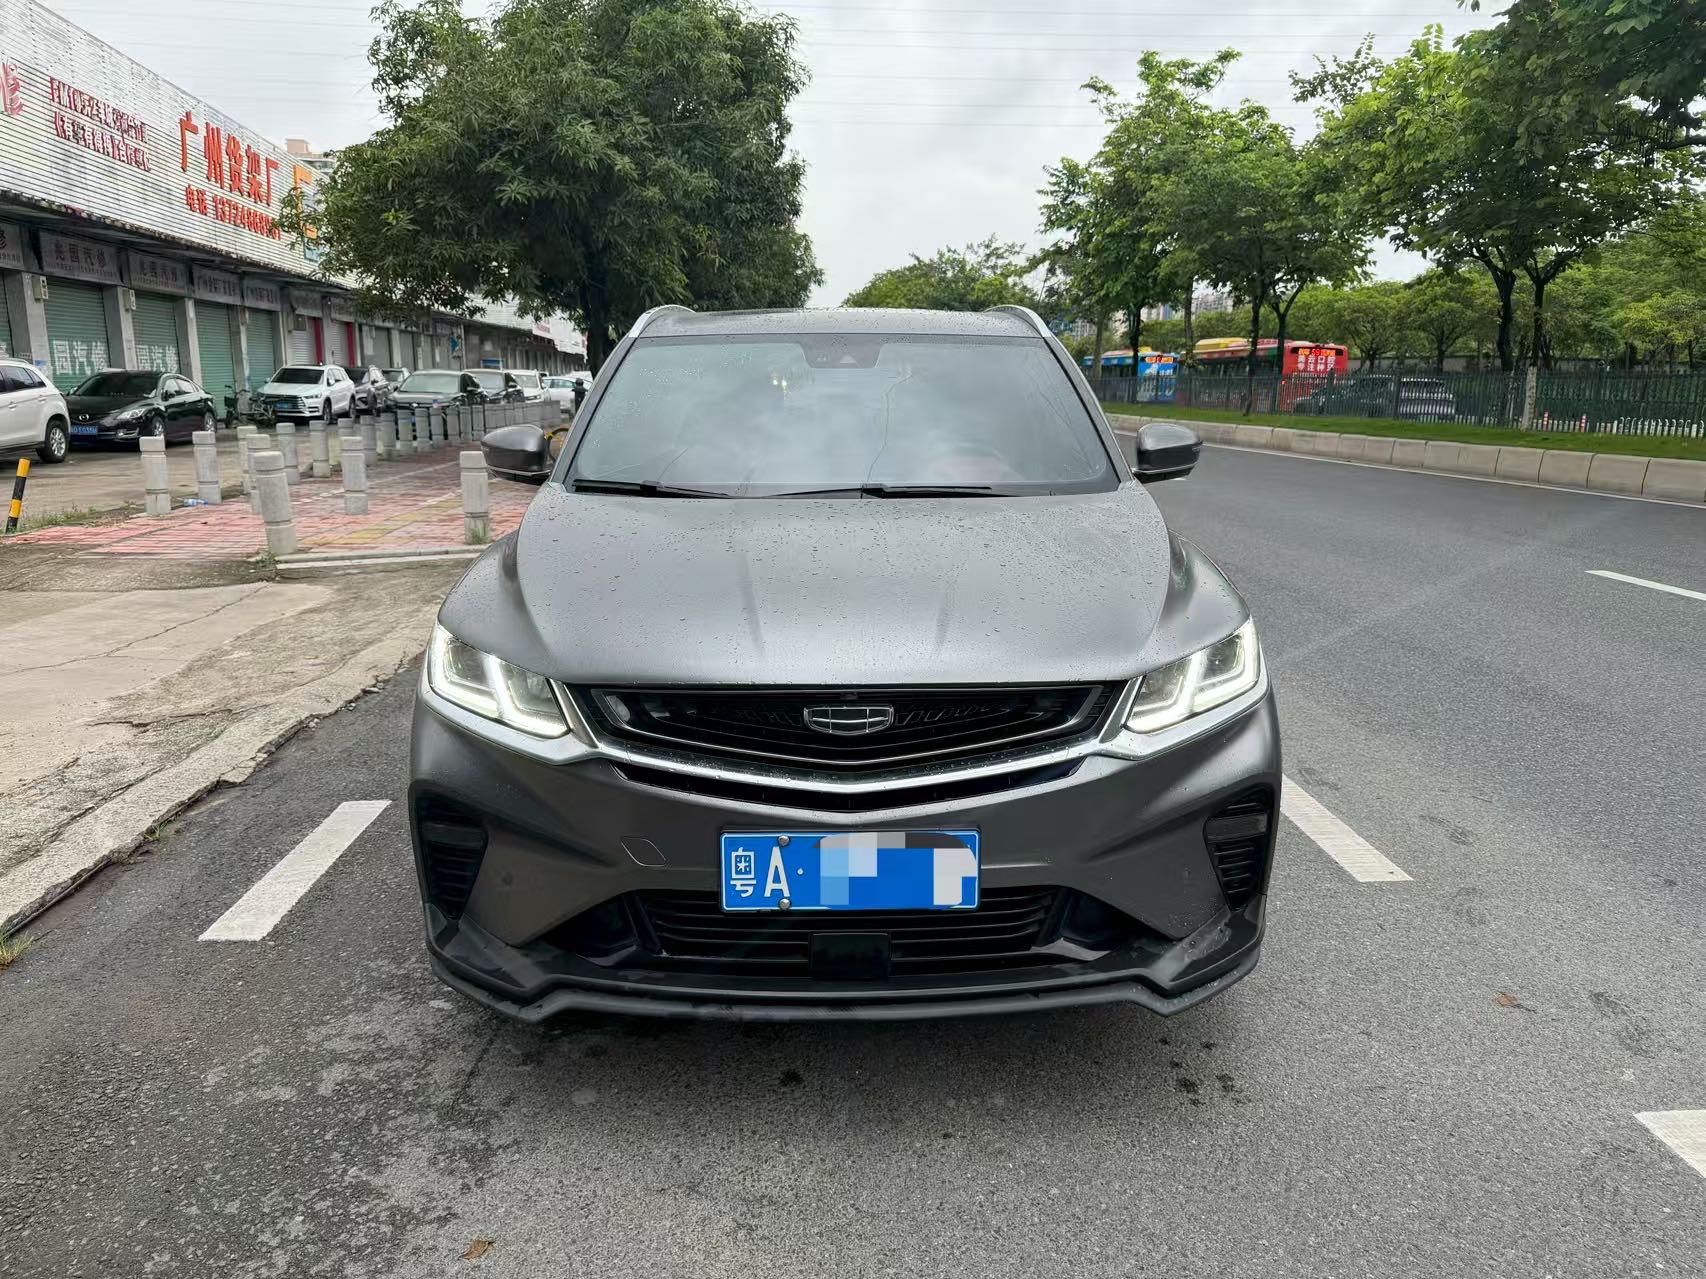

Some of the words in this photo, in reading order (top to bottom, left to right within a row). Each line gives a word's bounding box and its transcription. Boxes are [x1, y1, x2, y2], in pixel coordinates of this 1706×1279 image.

[179, 111, 280, 206] 广州货架厂
[185, 185, 207, 215] 电话
